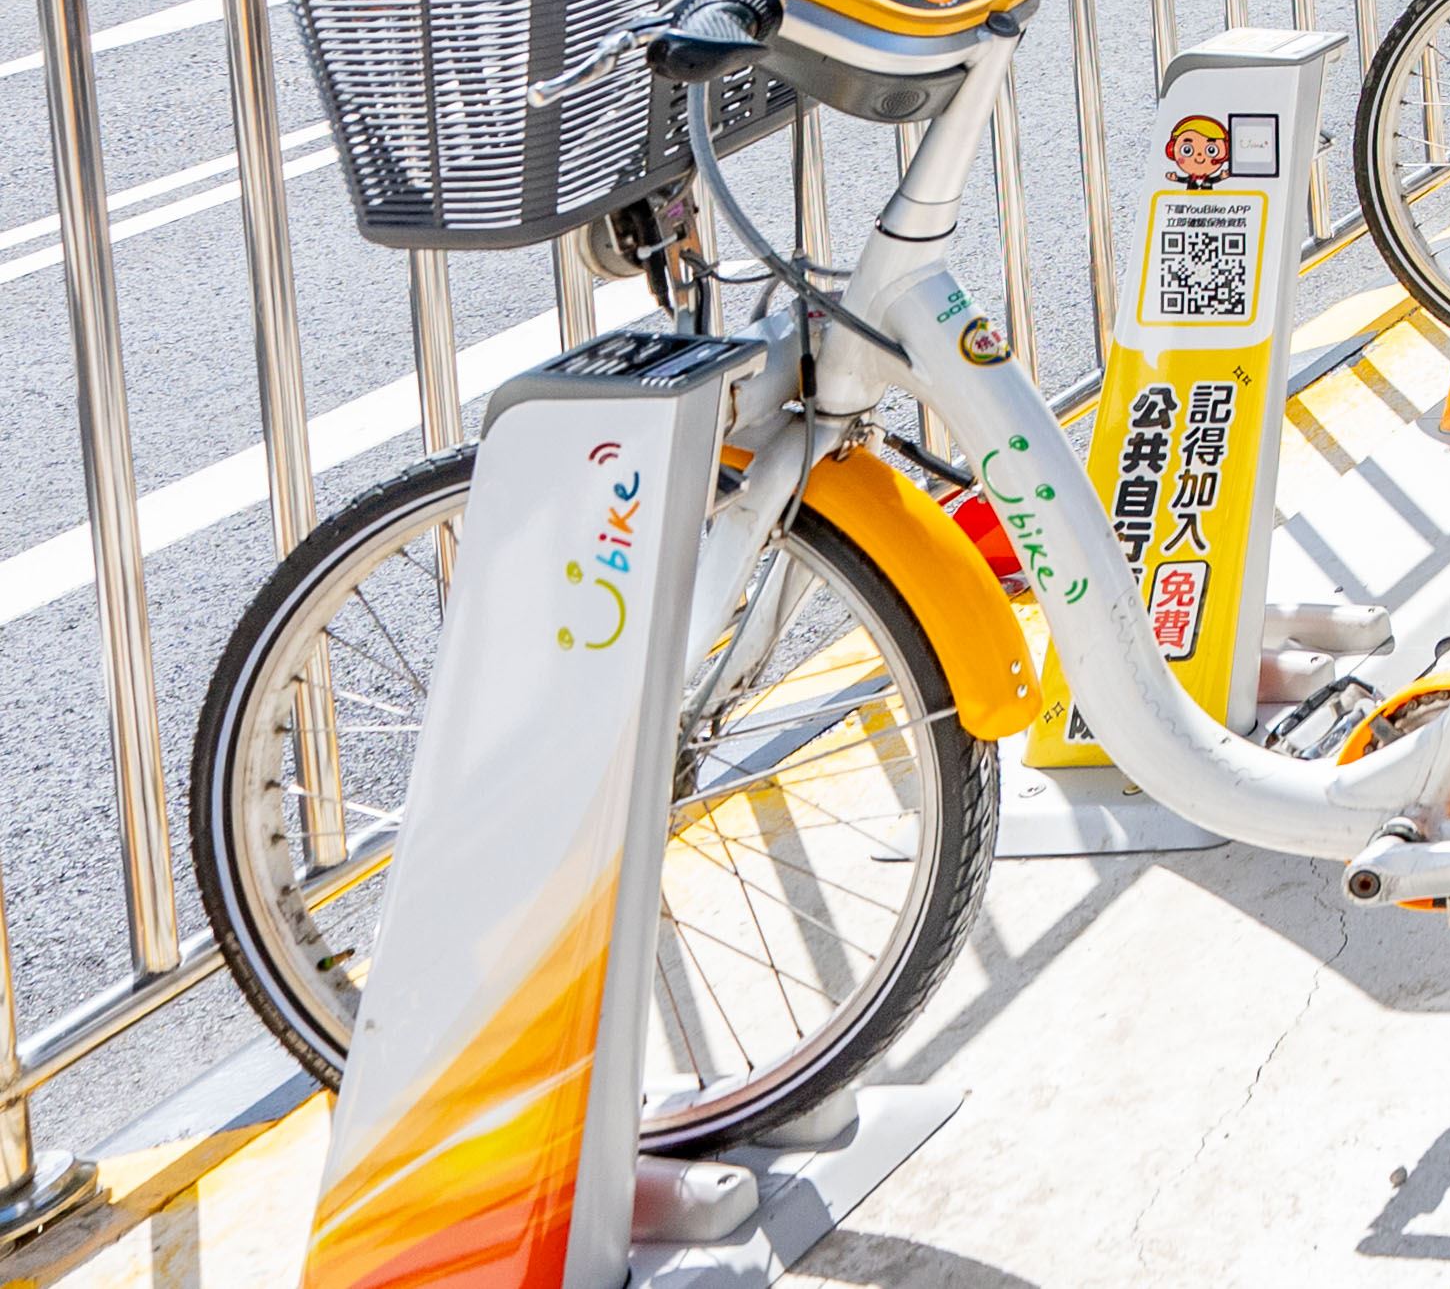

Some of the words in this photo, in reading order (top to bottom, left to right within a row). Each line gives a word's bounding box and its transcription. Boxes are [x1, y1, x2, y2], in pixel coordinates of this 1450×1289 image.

[1227, 205, 1251, 214] APP
[1113, 387, 1178, 587] 公共自行
[1165, 385, 1233, 552] 記得加入
[1153, 569, 1196, 651] 免費
